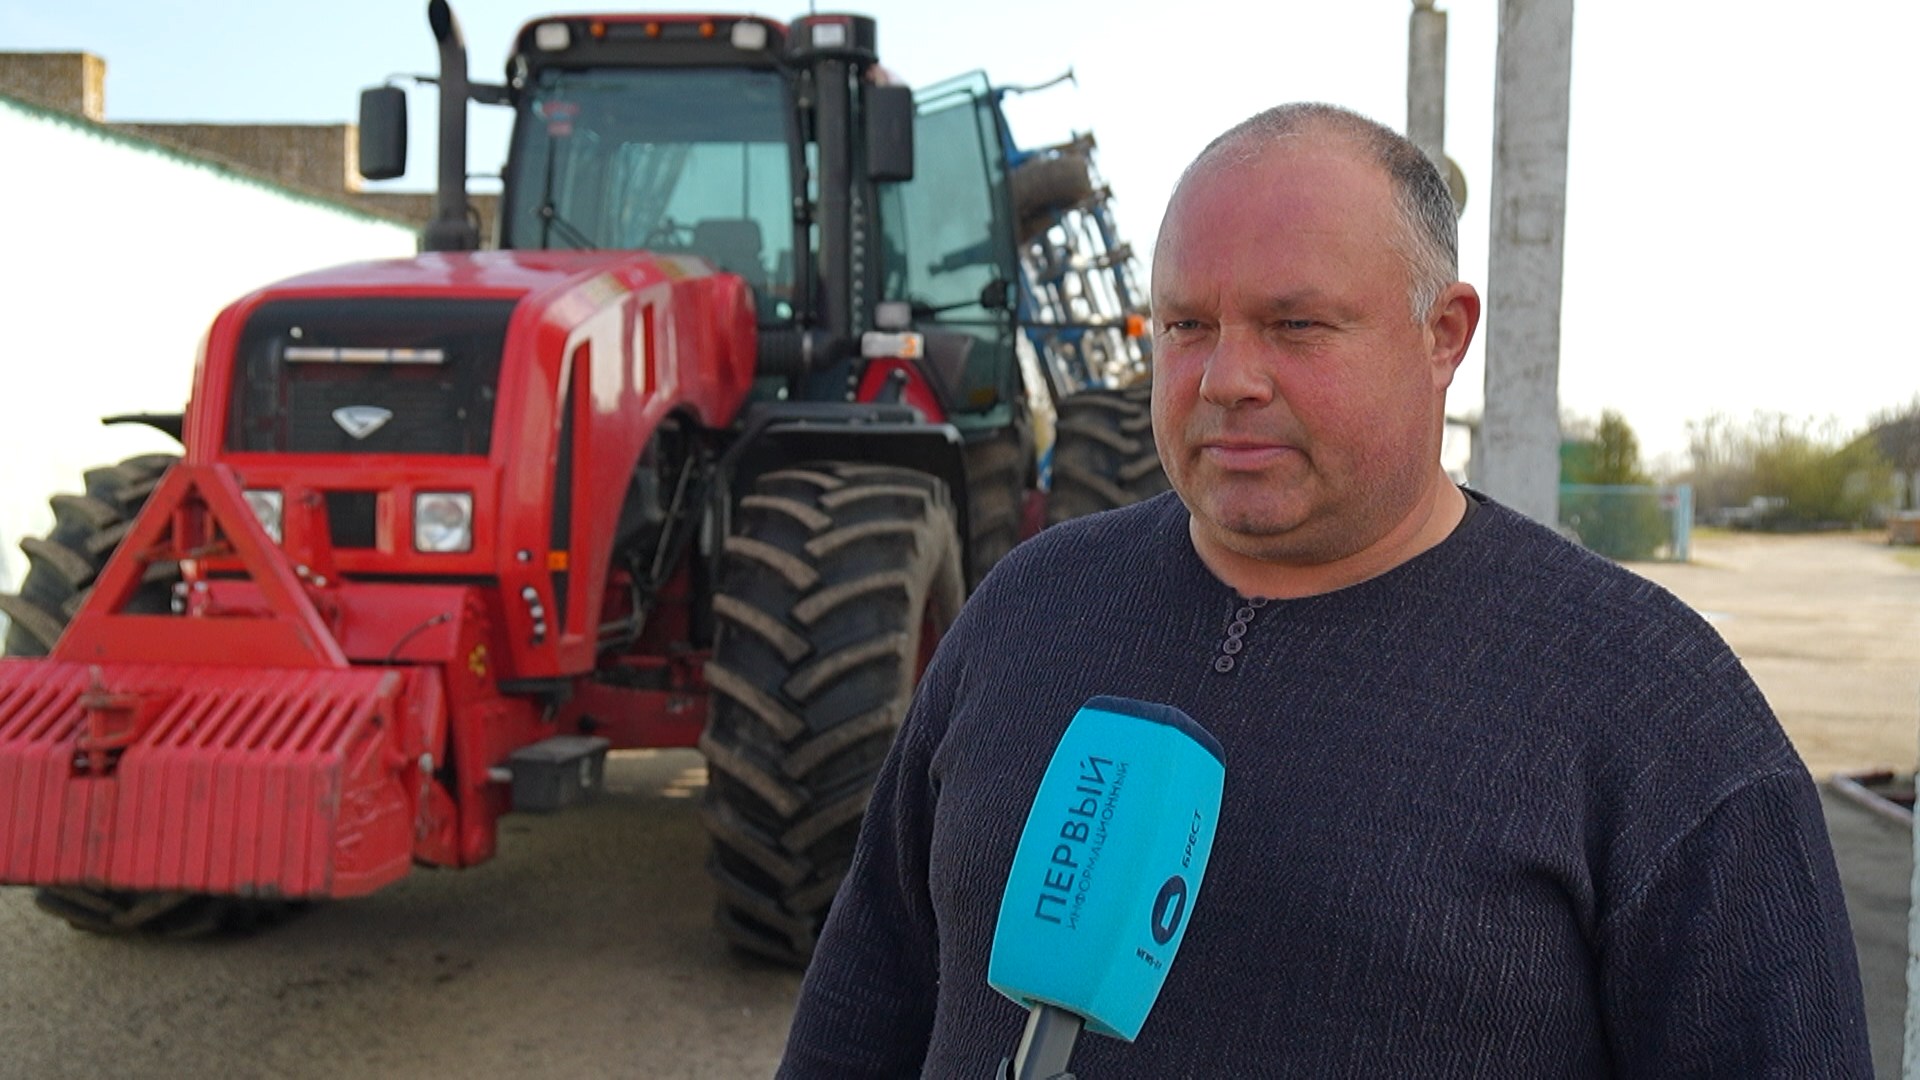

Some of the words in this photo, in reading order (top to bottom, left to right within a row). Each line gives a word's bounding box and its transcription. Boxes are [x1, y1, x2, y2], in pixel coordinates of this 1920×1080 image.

[1035, 755, 1113, 924] ПЕРВЫЙ
[1066, 762, 1128, 931] ИНФОРМАЦИОННЫЙ
[1182, 809, 1201, 868] БРЕСТ
